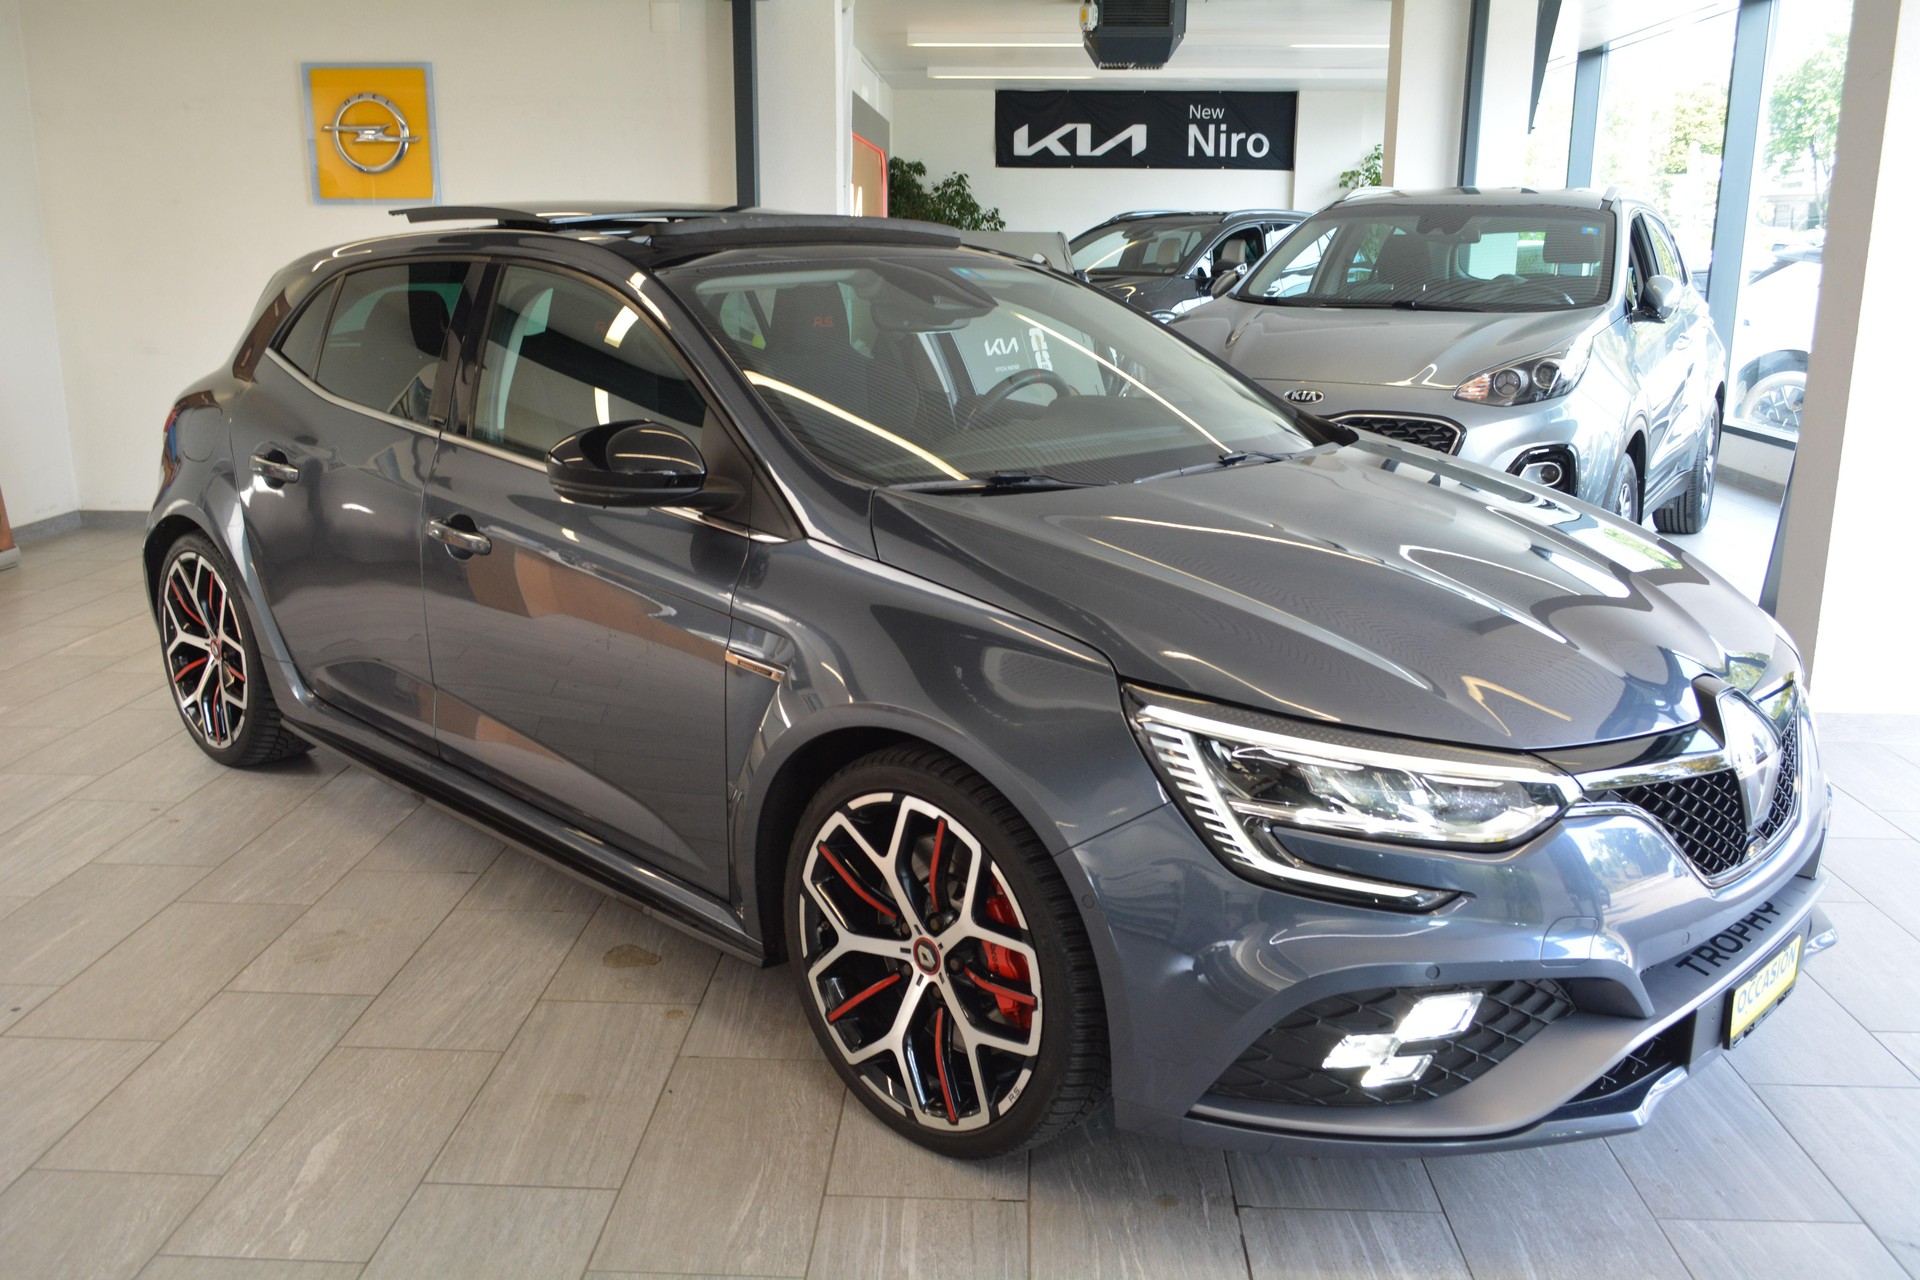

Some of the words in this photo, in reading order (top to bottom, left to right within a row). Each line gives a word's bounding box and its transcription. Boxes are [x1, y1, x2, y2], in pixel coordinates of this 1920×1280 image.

[1189, 104, 1225, 120] New
[1013, 123, 1147, 157] KIA
[1188, 123, 1270, 158] Niro
[984, 337, 1019, 356] KIA
[1291, 390, 1317, 401] KIA
[1674, 901, 1781, 976] TROPHY
[1737, 944, 1798, 1014] OCCASION
